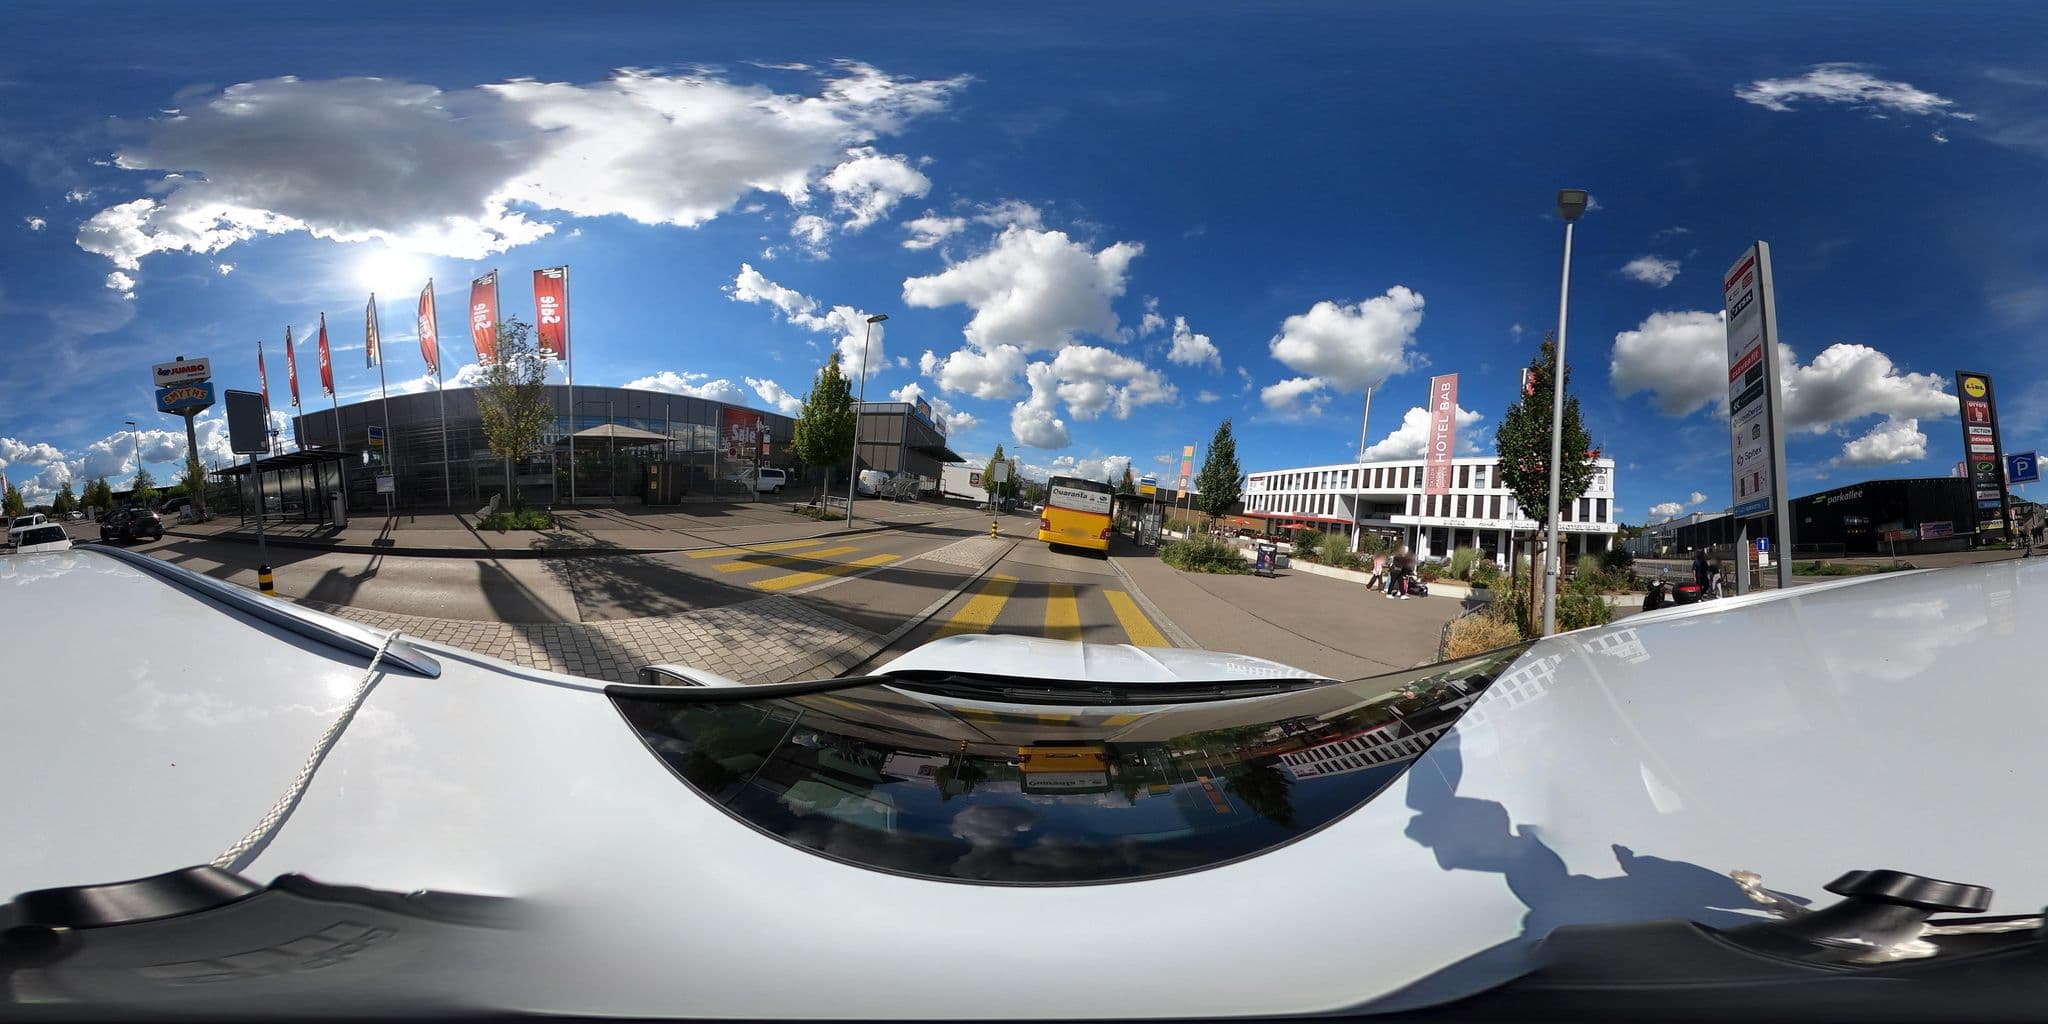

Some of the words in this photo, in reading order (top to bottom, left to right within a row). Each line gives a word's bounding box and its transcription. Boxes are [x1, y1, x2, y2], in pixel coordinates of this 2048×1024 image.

[171, 365, 204, 375] JUMBO
[164, 388, 206, 404] SMYTHS
[1440, 382, 1450, 411] BAB
[732, 424, 756, 443] Sale
[1435, 415, 1449, 463] HOTEL
[1745, 447, 1762, 462] Spitex
[2016, 461, 2029, 476] P
[1053, 489, 1088, 499] Quaranta
[1827, 490, 1863, 506] parkallee
